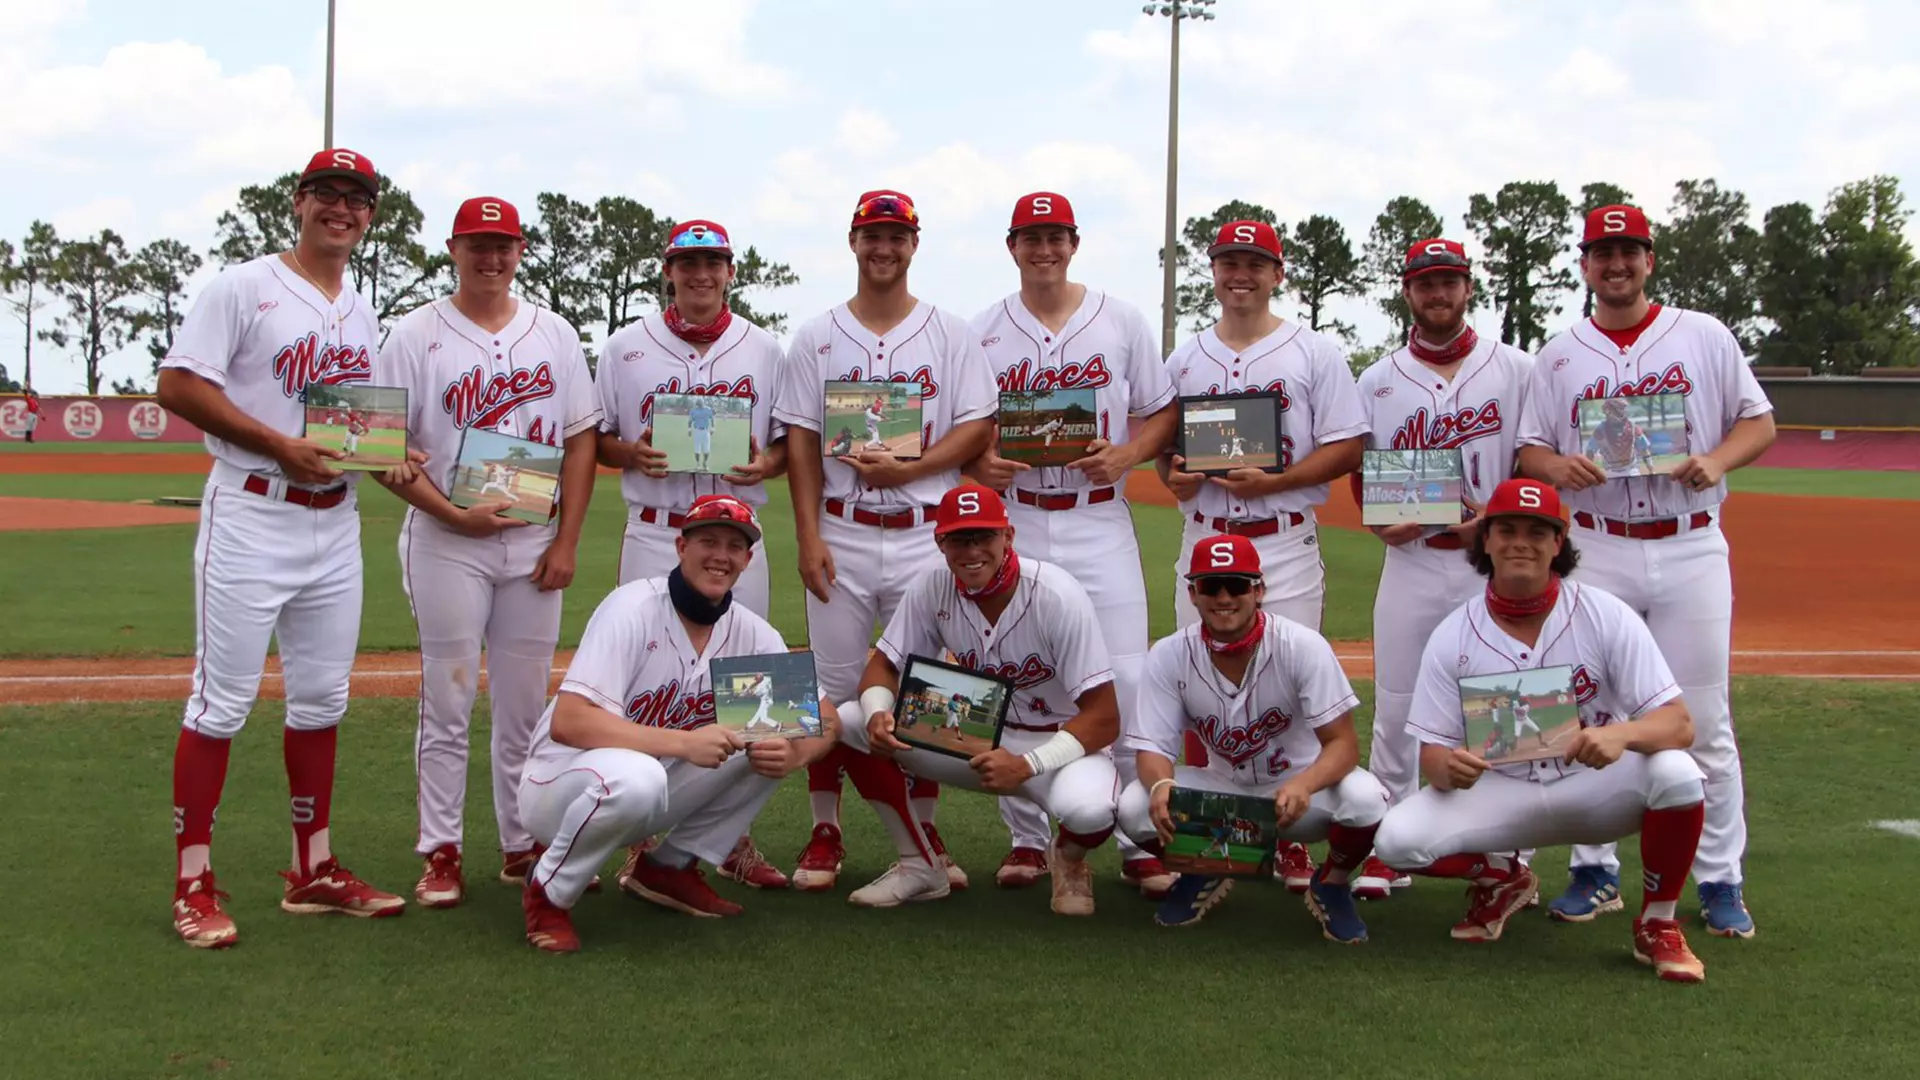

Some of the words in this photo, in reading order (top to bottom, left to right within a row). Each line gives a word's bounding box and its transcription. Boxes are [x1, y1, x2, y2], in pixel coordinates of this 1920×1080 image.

[333, 152, 356, 169] S
[482, 202, 501, 221] S
[1032, 197, 1052, 215] S
[1603, 211, 1626, 233] S
[1233, 226, 1257, 243] S
[273, 331, 371, 398] Mocs
[442, 361, 556, 430] Mocs
[70, 405, 96, 426] 35
[134, 406, 160, 428] 43
[1390, 399, 1502, 450] Mocs
[958, 492, 980, 515] S
[1519, 486, 1541, 508] S
[1211, 543, 1234, 567] S
[959, 649, 1055, 691] ocs
[626, 679, 717, 731] Moc
[291, 797, 315, 823] S
